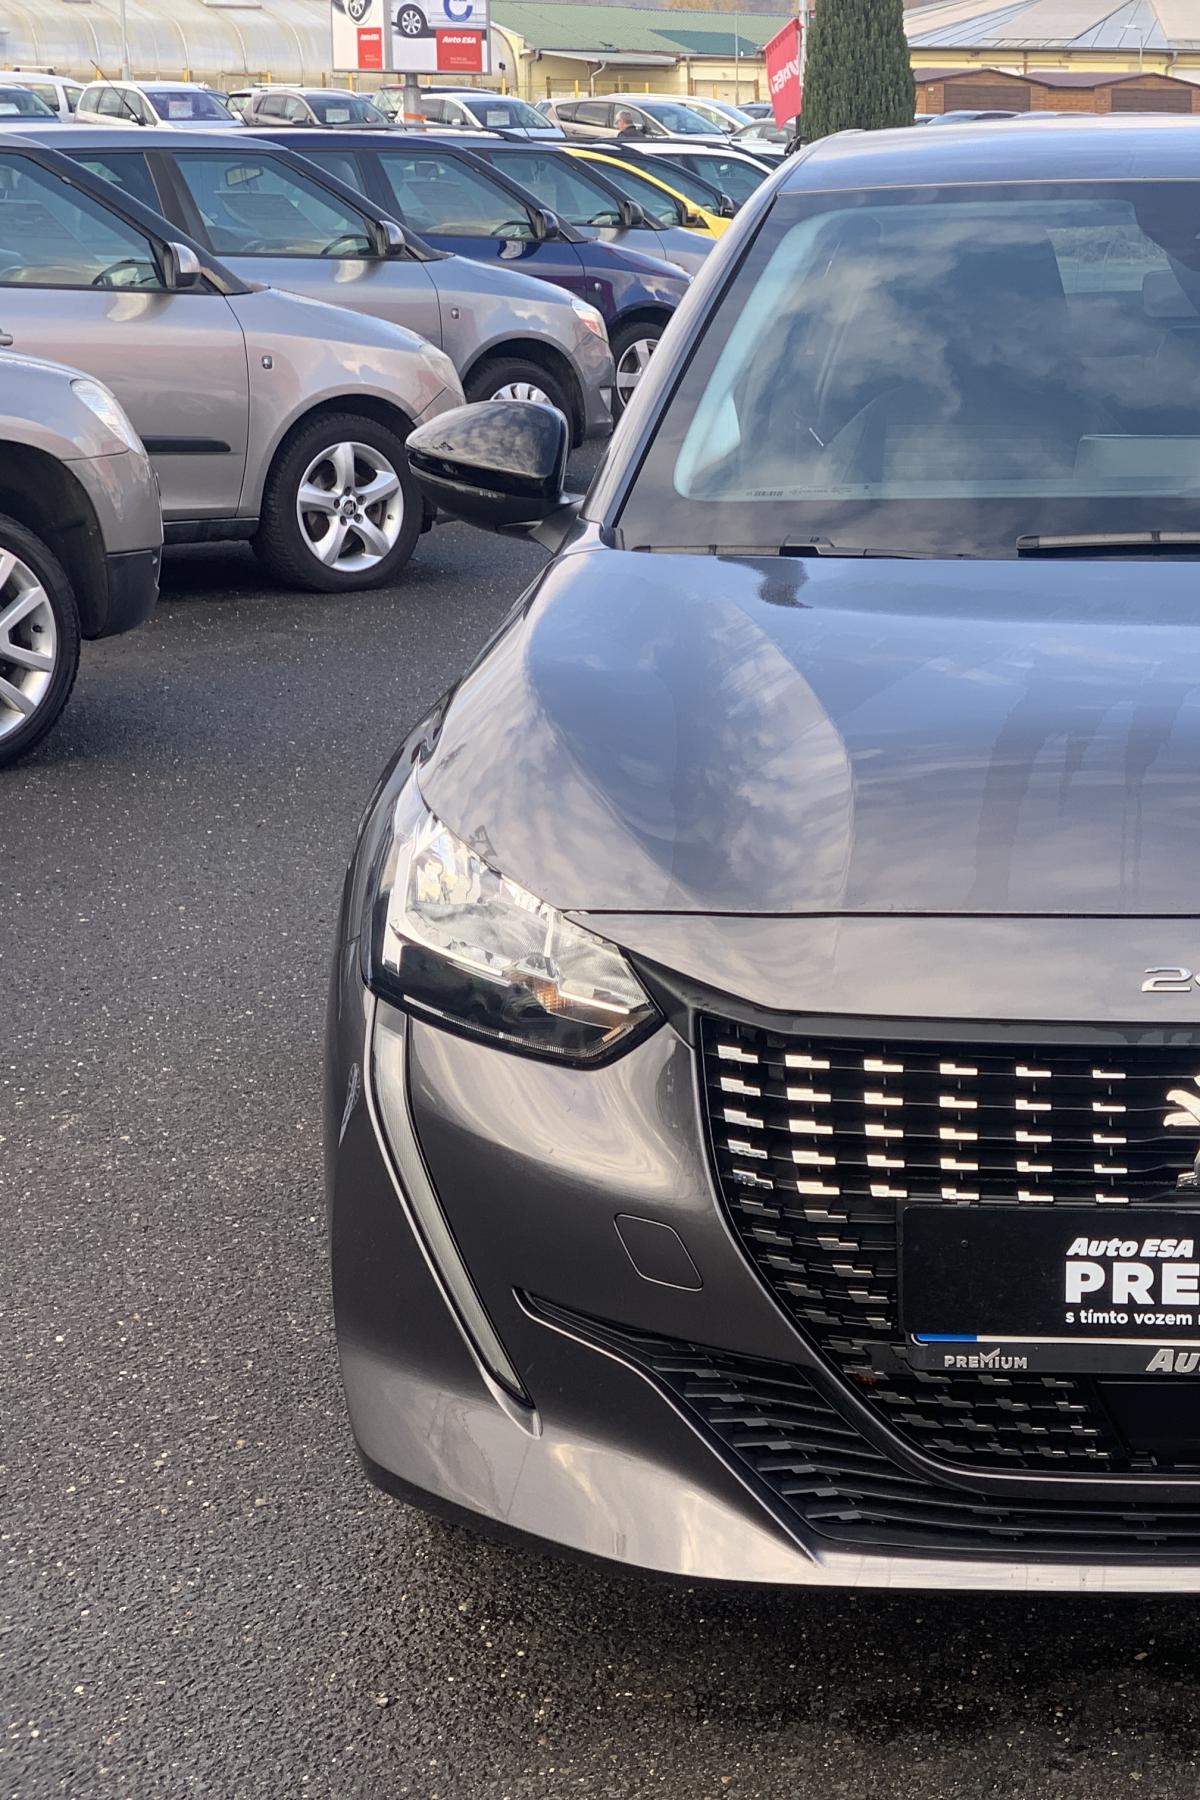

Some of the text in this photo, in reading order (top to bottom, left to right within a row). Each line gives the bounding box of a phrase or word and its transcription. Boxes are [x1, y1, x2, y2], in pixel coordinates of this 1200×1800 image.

[442, 36, 477, 44] Auto ESA
[1066, 1237, 1195, 1259] Auto ESA
[1065, 1312, 1076, 1325] s
[1079, 1309, 1129, 1325] tímto
[1134, 1313, 1193, 1326] vozem
[944, 1351, 1028, 1370] PREMIUM
